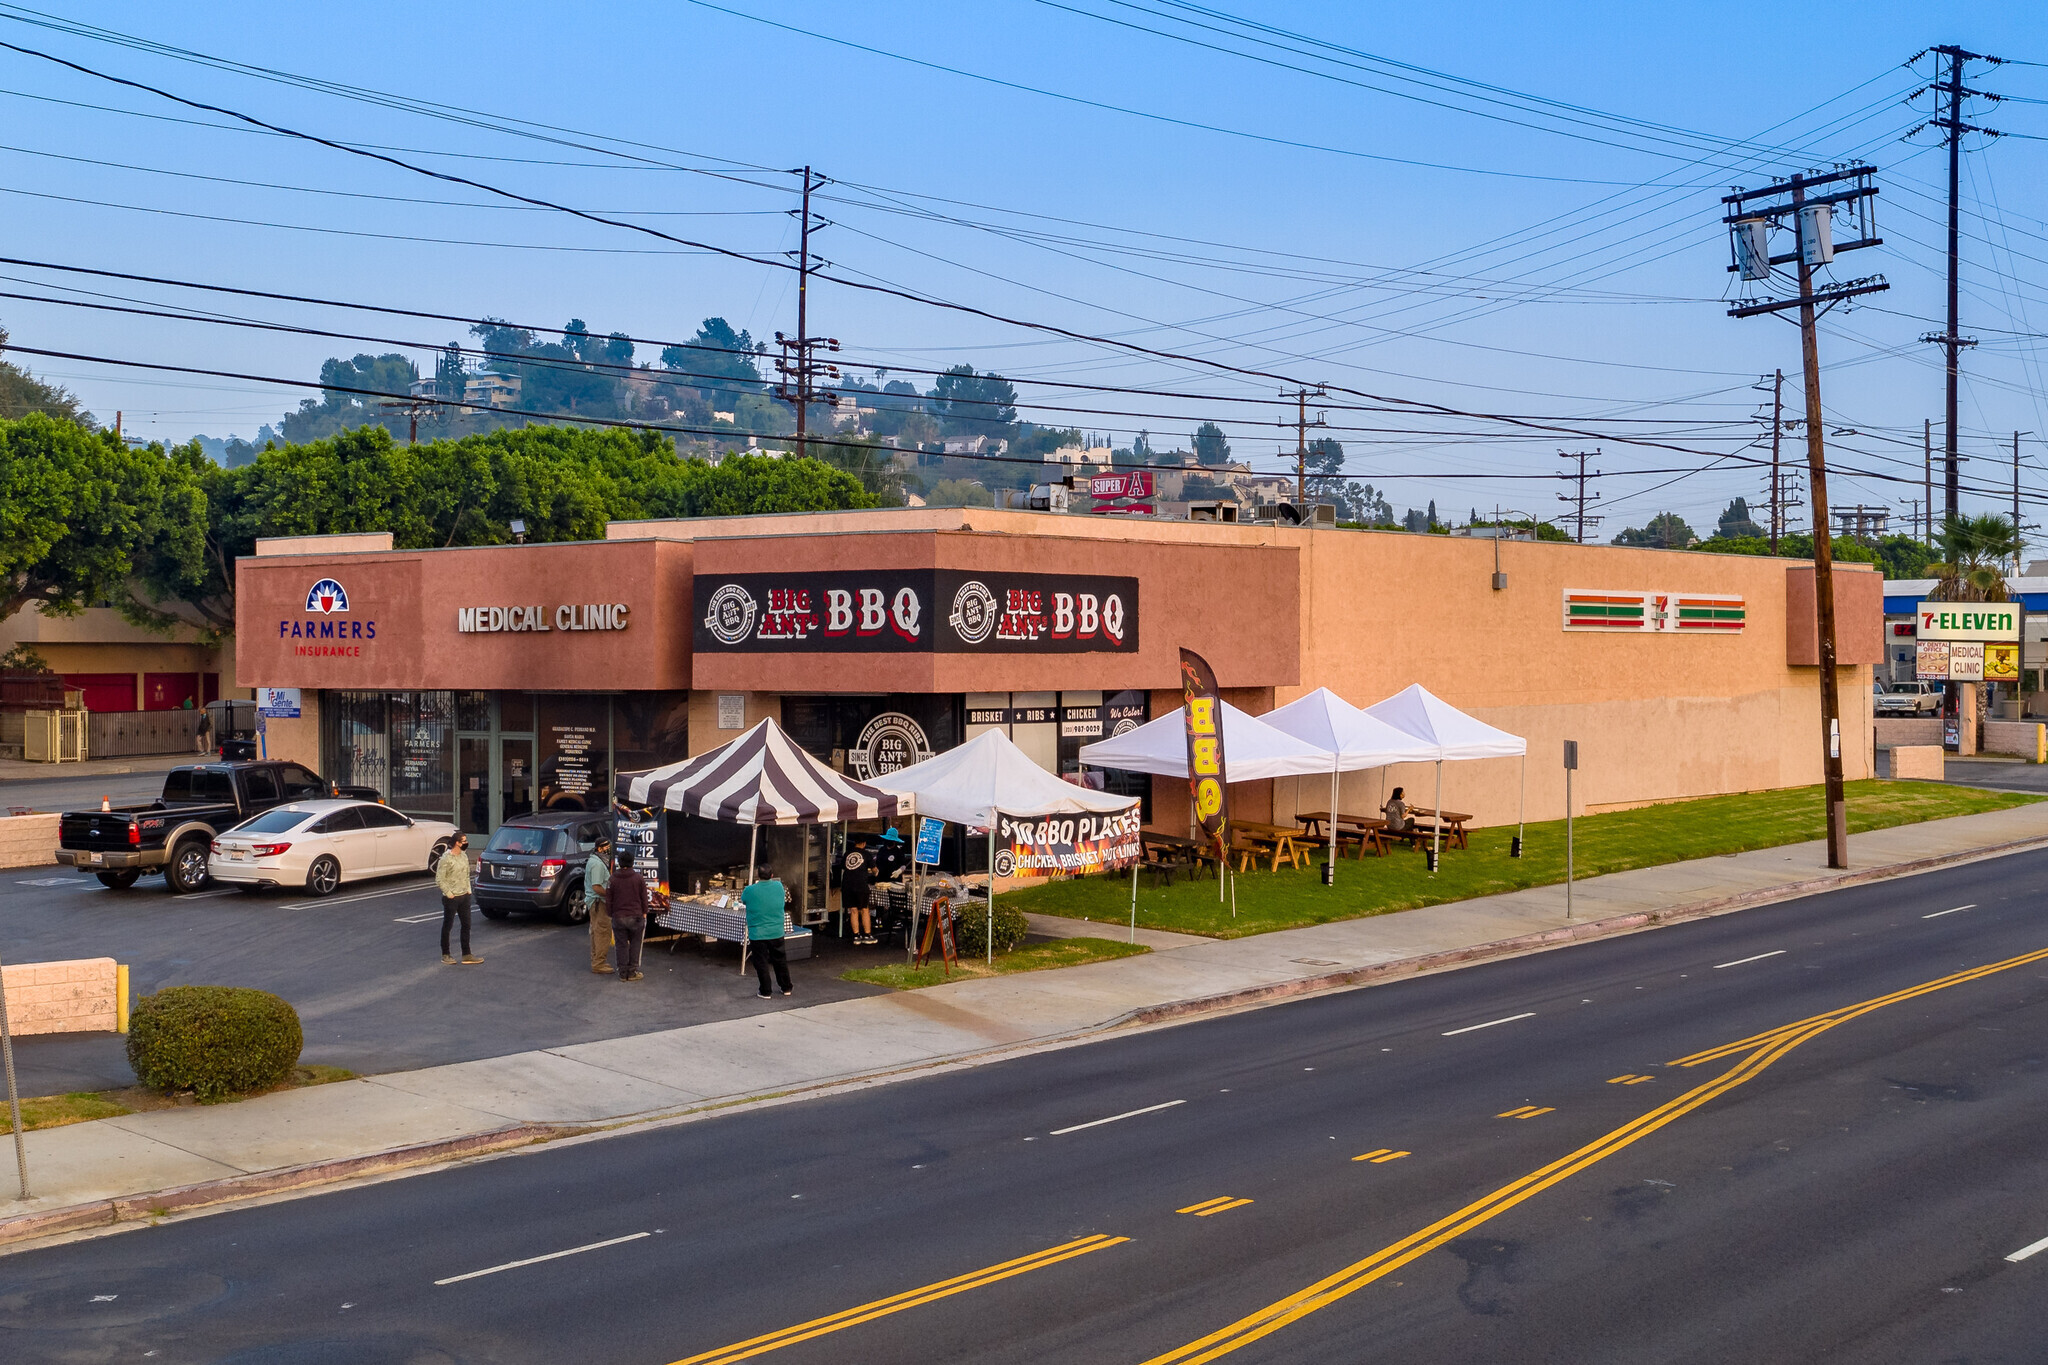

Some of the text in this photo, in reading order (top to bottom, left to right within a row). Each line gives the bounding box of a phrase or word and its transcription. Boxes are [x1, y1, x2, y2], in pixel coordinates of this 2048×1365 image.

[1094, 471, 1144, 496] SUPER A
[722, 601, 735, 611] BIG
[768, 588, 812, 614] BIG
[966, 598, 978, 608] BIG
[1006, 589, 1043, 614] BIG
[458, 604, 630, 632] MEDICAL CLINIC
[725, 615, 740, 627] BBQ
[823, 587, 921, 643] BBQ
[967, 613, 981, 625] BBQ
[1051, 592, 1124, 646] BBQ
[280, 620, 376, 639] FARMERS
[295, 645, 360, 657] INSURANCE
[1951, 647, 1983, 658] MEDICAL
[1954, 662, 1980, 673] CLINIC
[971, 711, 1003, 723] BRISKET
[1026, 710, 1045, 721] RIBS
[1067, 708, 1097, 720] CHICKEN
[1110, 705, 1144, 718] We Cater!
[862, 717, 924, 744] THE BEST BBQ RIBS
[404, 740, 441, 748] FARMERS
[882, 739, 902, 750] BIG
[850, 752, 867, 762] SINCE
[1001, 808, 1140, 847] $10 BBQ PLATES
[1017, 854, 1061, 869] CHICKEN,
[1103, 847, 1117, 862] HOT
[1119, 843, 1140, 859] LINKS
